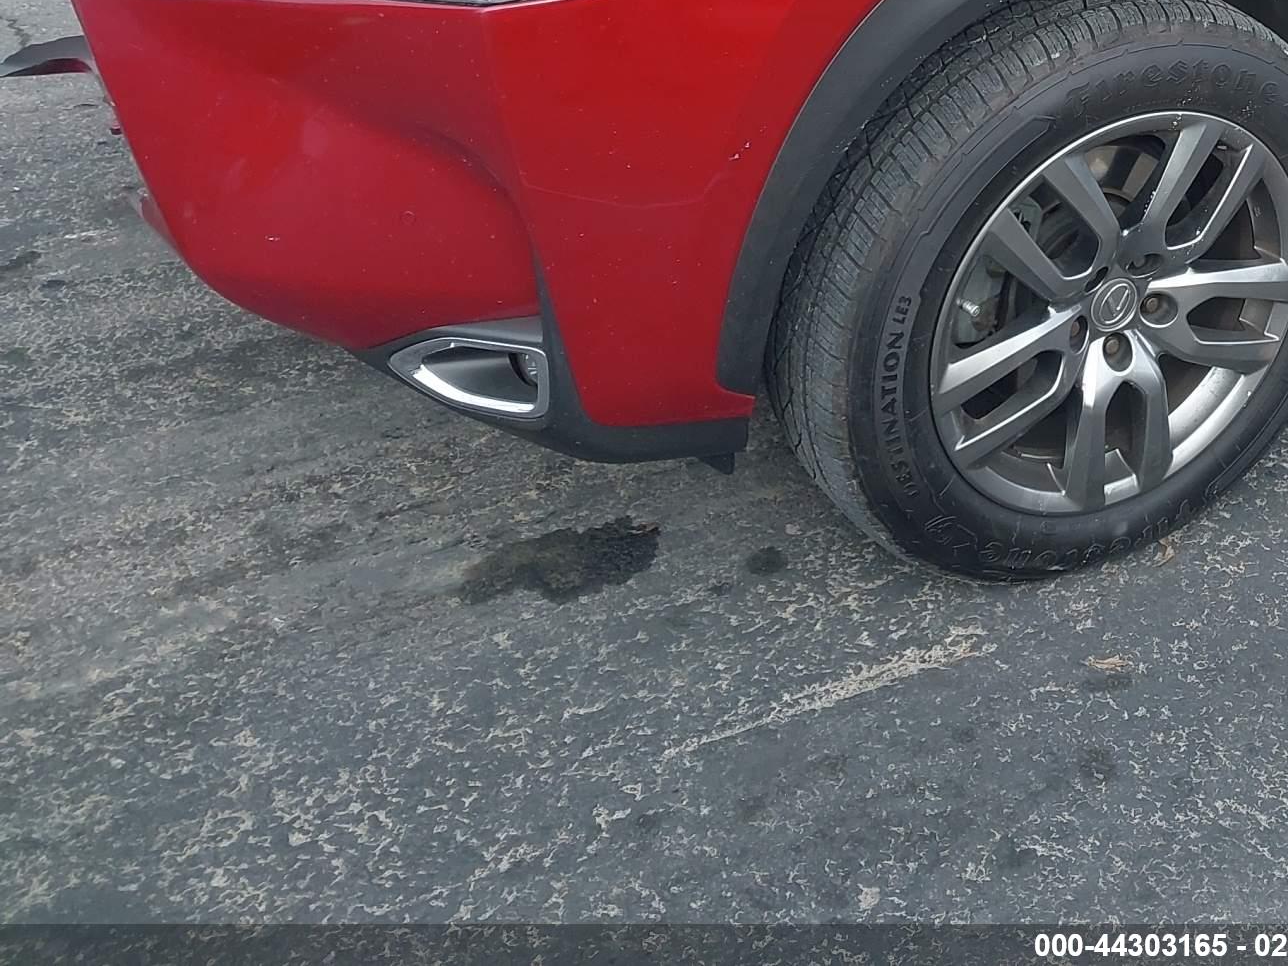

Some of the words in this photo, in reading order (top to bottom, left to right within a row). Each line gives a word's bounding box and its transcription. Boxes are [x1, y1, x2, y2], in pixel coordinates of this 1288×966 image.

[1065, 58, 1281, 117] Firestone
[892, 295, 912, 325] LE3
[880, 330, 919, 499] DESTINATION
